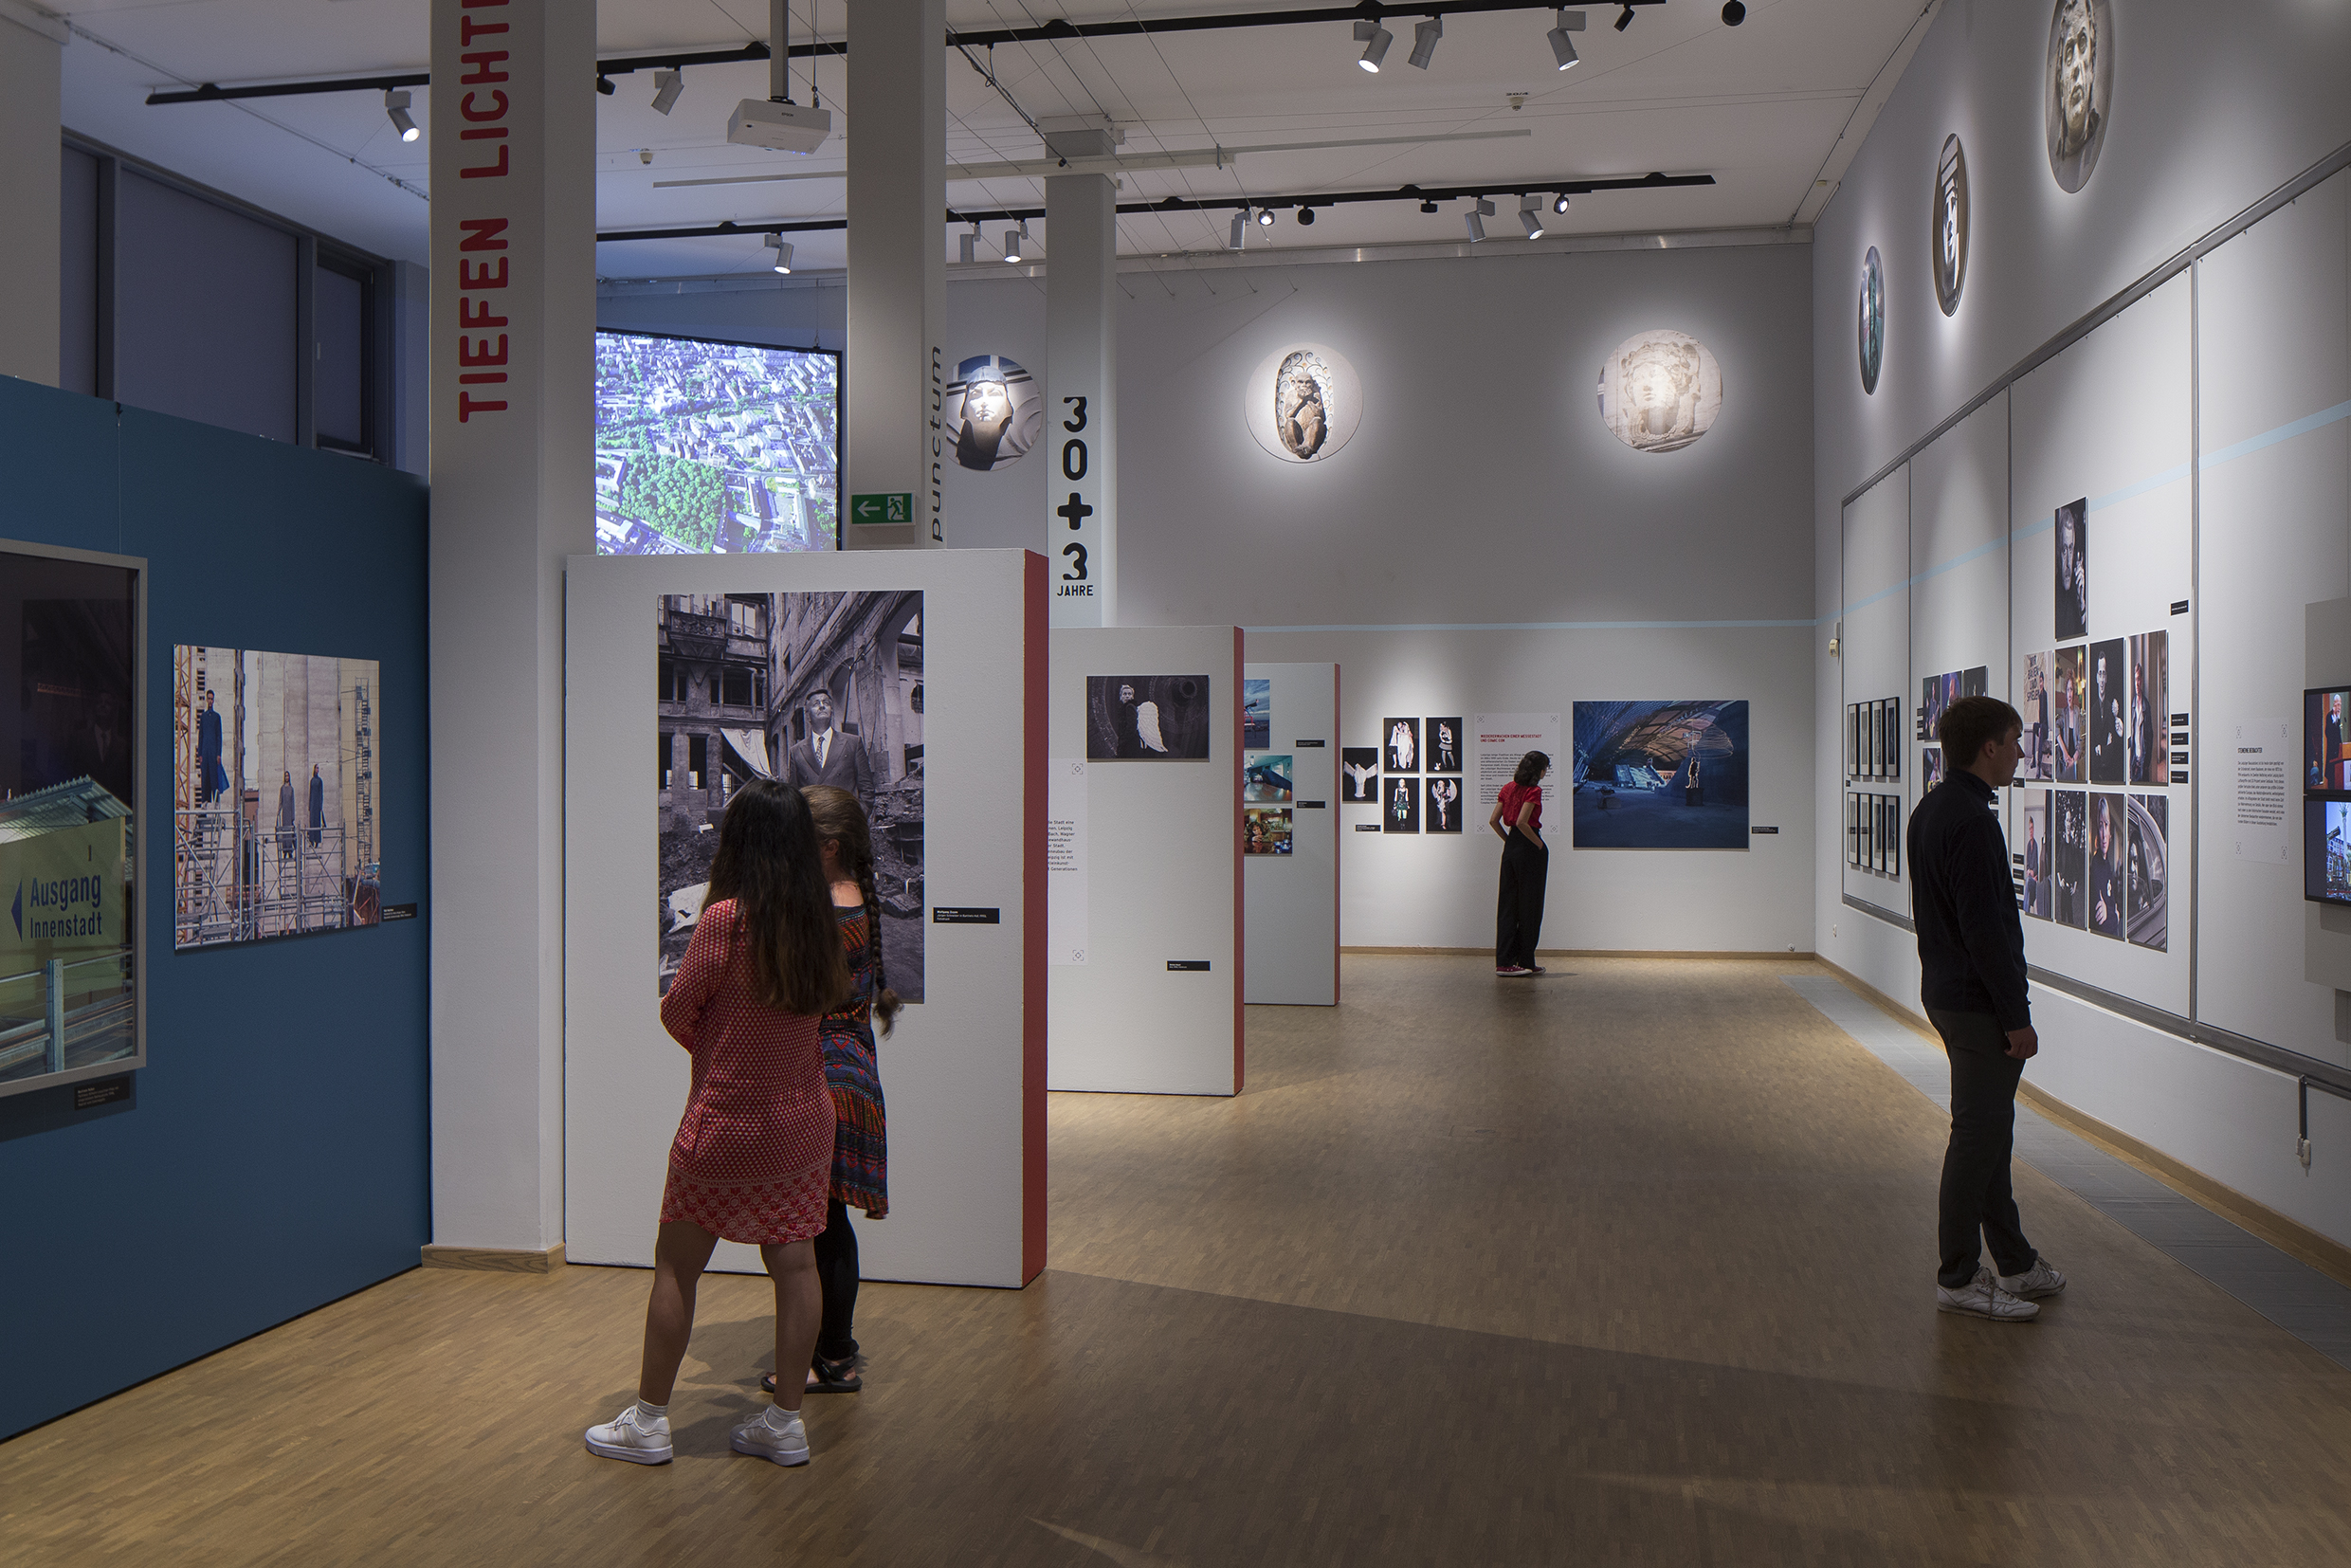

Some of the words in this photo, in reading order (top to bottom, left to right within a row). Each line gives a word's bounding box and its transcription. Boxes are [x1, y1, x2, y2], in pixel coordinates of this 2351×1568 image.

[461, 0, 511, 178] LICHT
[459, 217, 509, 423] TIEFEN
[929, 346, 943, 542] punctum
[1057, 585, 1094, 596] JAHRE
[30, 874, 101, 911] Ausgang
[30, 912, 102, 939] Innenstadt
